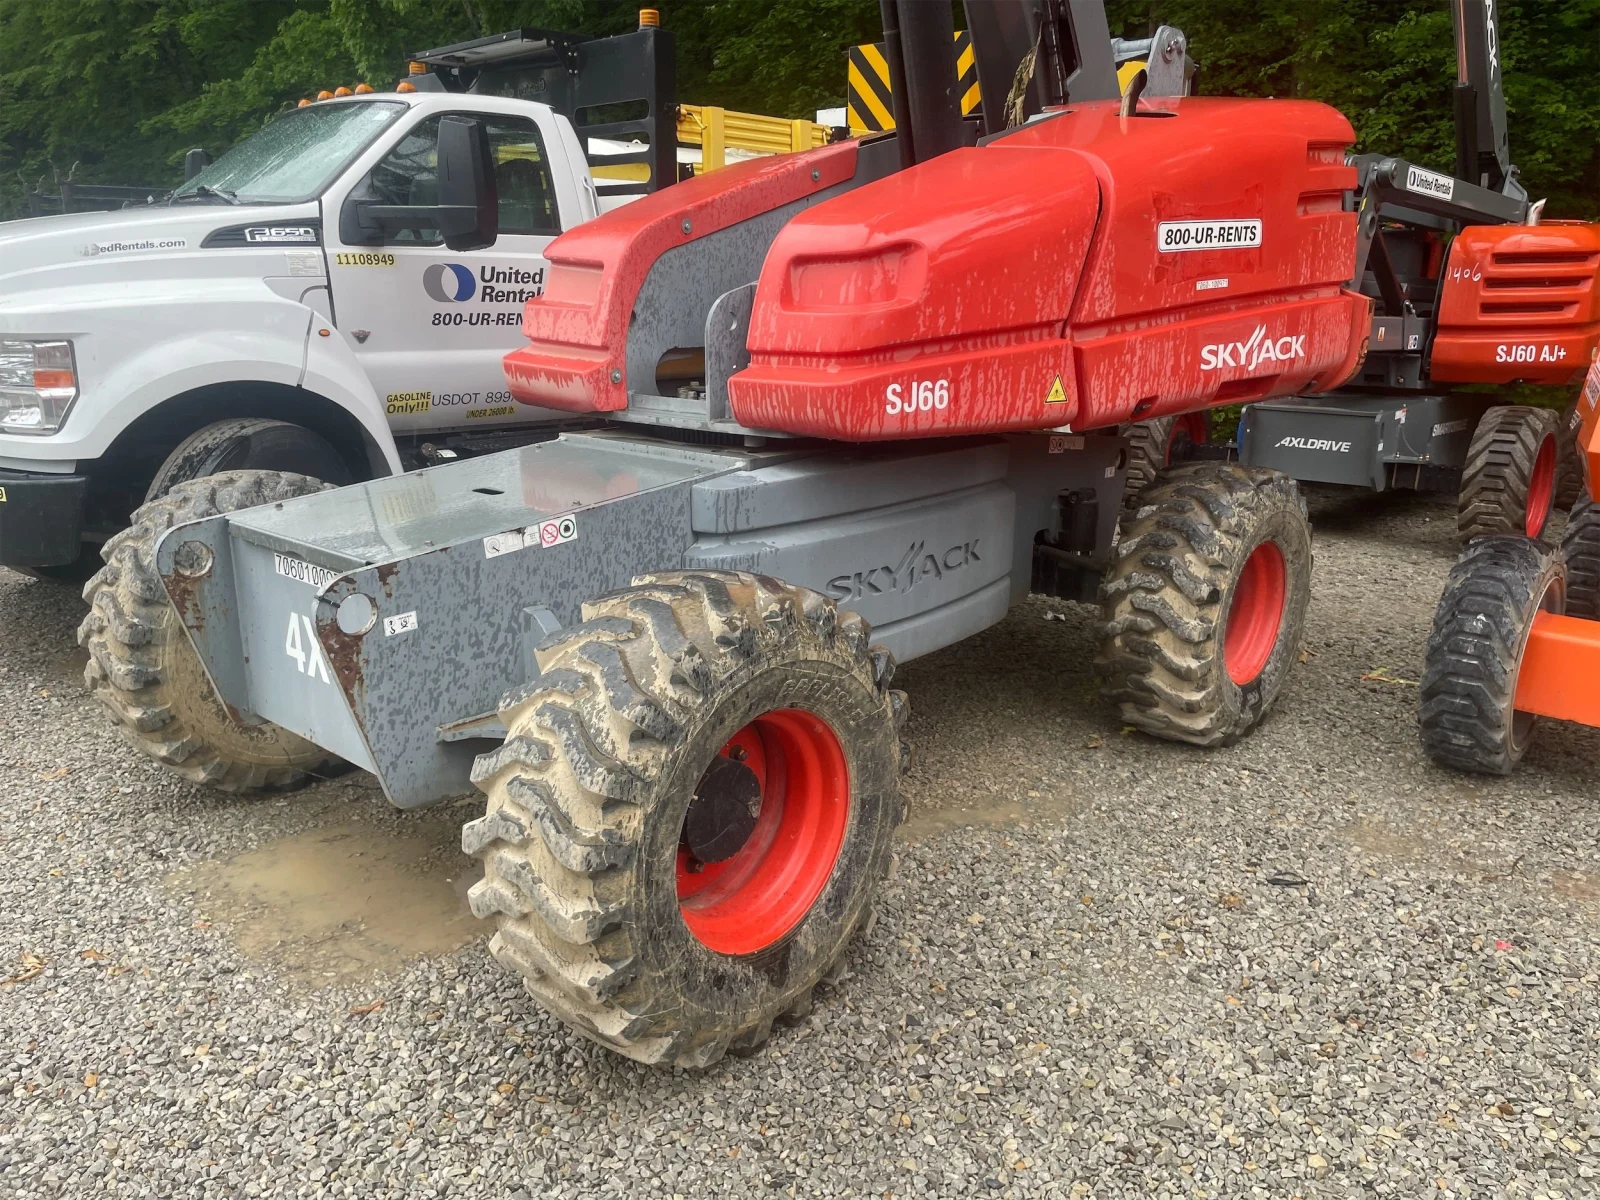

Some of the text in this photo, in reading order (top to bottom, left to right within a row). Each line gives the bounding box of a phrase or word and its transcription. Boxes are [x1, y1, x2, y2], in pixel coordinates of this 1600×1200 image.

[1416, 173, 1451, 196] United Rentals
[1164, 225, 1257, 246] 800-UR-RENTS
[336, 253, 395, 266] 11108949
[480, 265, 544, 285] United
[1447, 262, 1482, 284] 1406
[481, 285, 545, 303] Rental
[431, 312, 524, 326] 800-UR-REN
[1200, 323, 1306, 371] SKYJACK
[1495, 345, 1566, 362] SJ60 AJ+
[386, 391, 431, 403] GASOLINE
[431, 391, 514, 407] USDOT 899
[885, 379, 949, 415] SJ66
[386, 401, 429, 414] Only!!!
[466, 409, 487, 419] UNDER
[488, 406, 507, 416] 26000
[825, 539, 981, 605] SKYJACK
